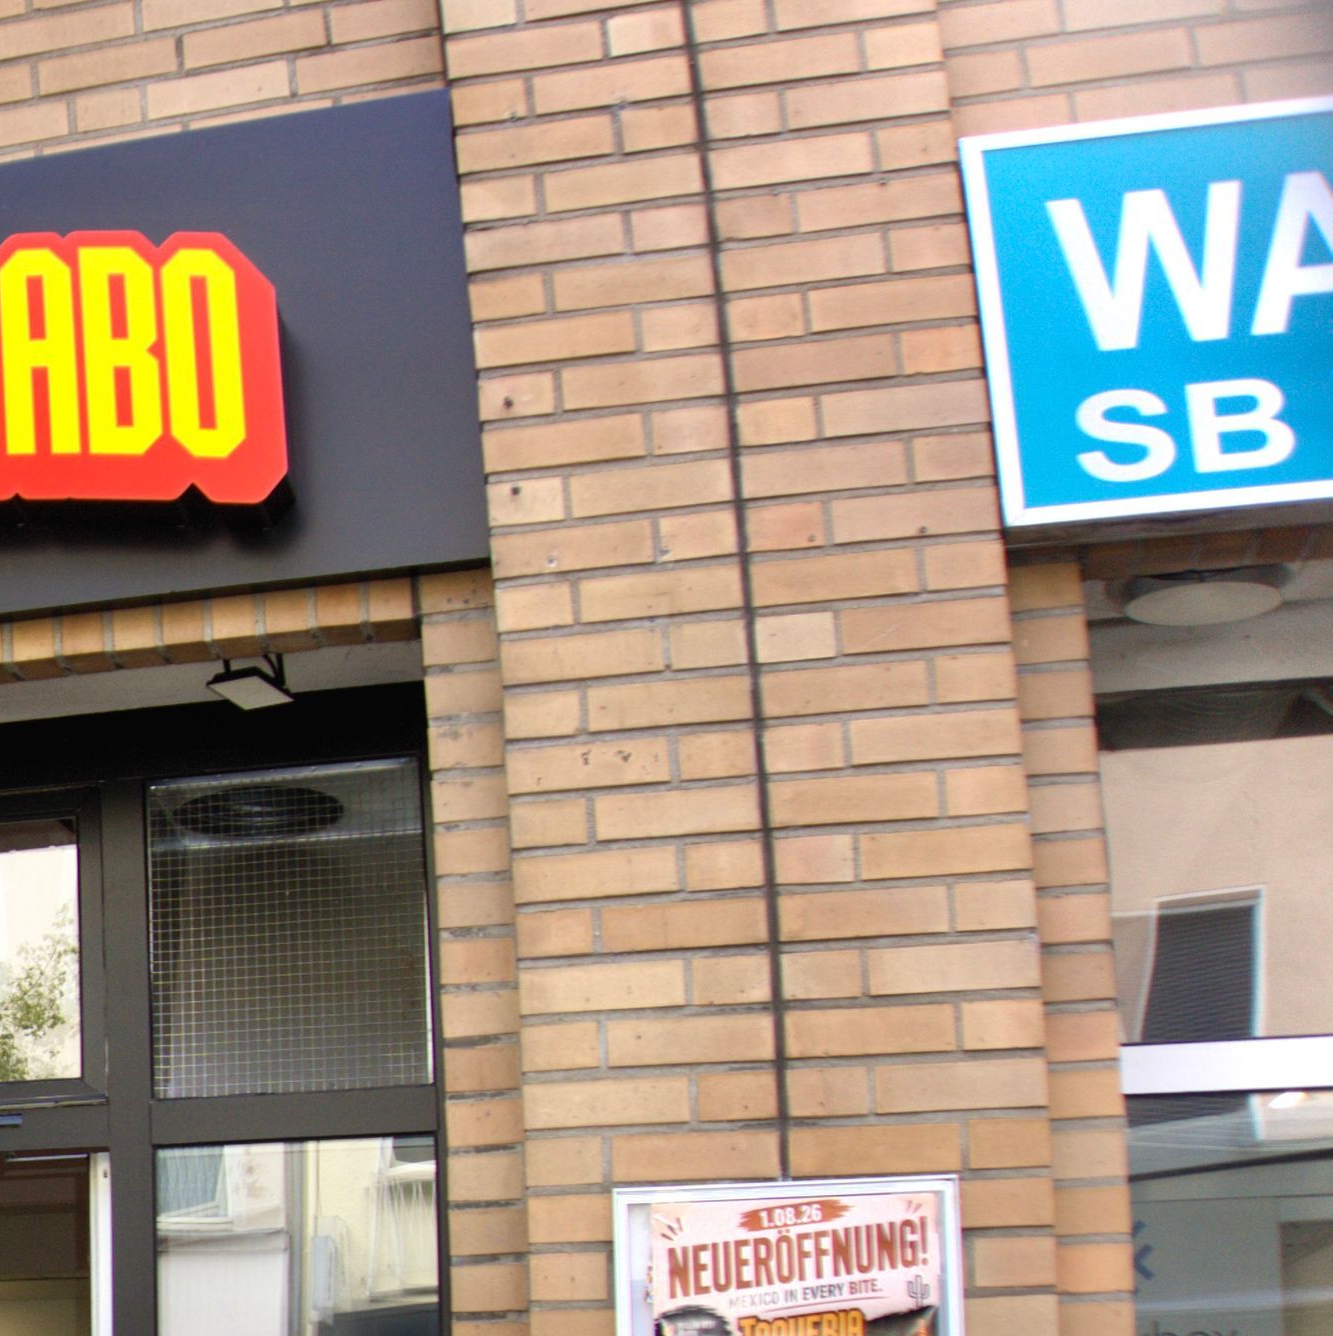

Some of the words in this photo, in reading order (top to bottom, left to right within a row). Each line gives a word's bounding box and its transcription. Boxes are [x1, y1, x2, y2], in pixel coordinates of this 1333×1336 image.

[1044, 170, 1333, 352] WA
[1075, 378, 1296, 482] SB
[668, 1216, 929, 1299] NEUERÖFFNUNG!
[784, 1289, 798, 1303] IN
[803, 1283, 845, 1300] EVERY
